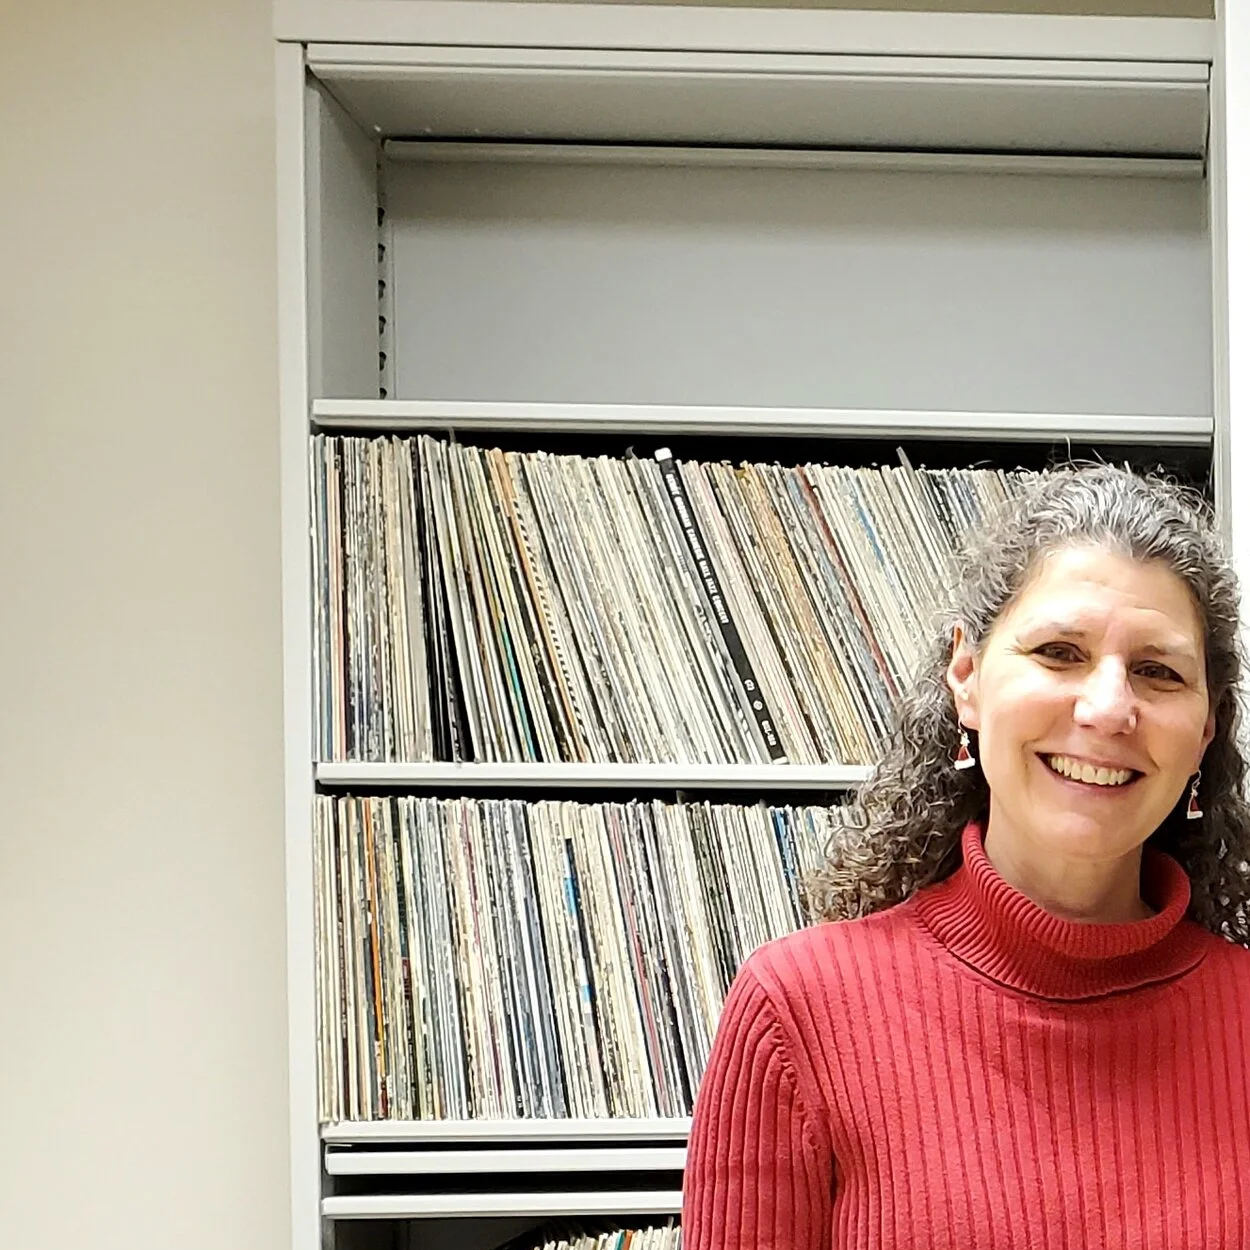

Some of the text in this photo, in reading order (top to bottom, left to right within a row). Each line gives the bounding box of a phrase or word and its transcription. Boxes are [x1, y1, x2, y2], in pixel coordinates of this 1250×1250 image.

[686, 528, 705, 560] CARNEGIE
[699, 560, 711, 578] HALL
[705, 578, 718, 595] JAZZ
[712, 595, 729, 624] CONCERT
